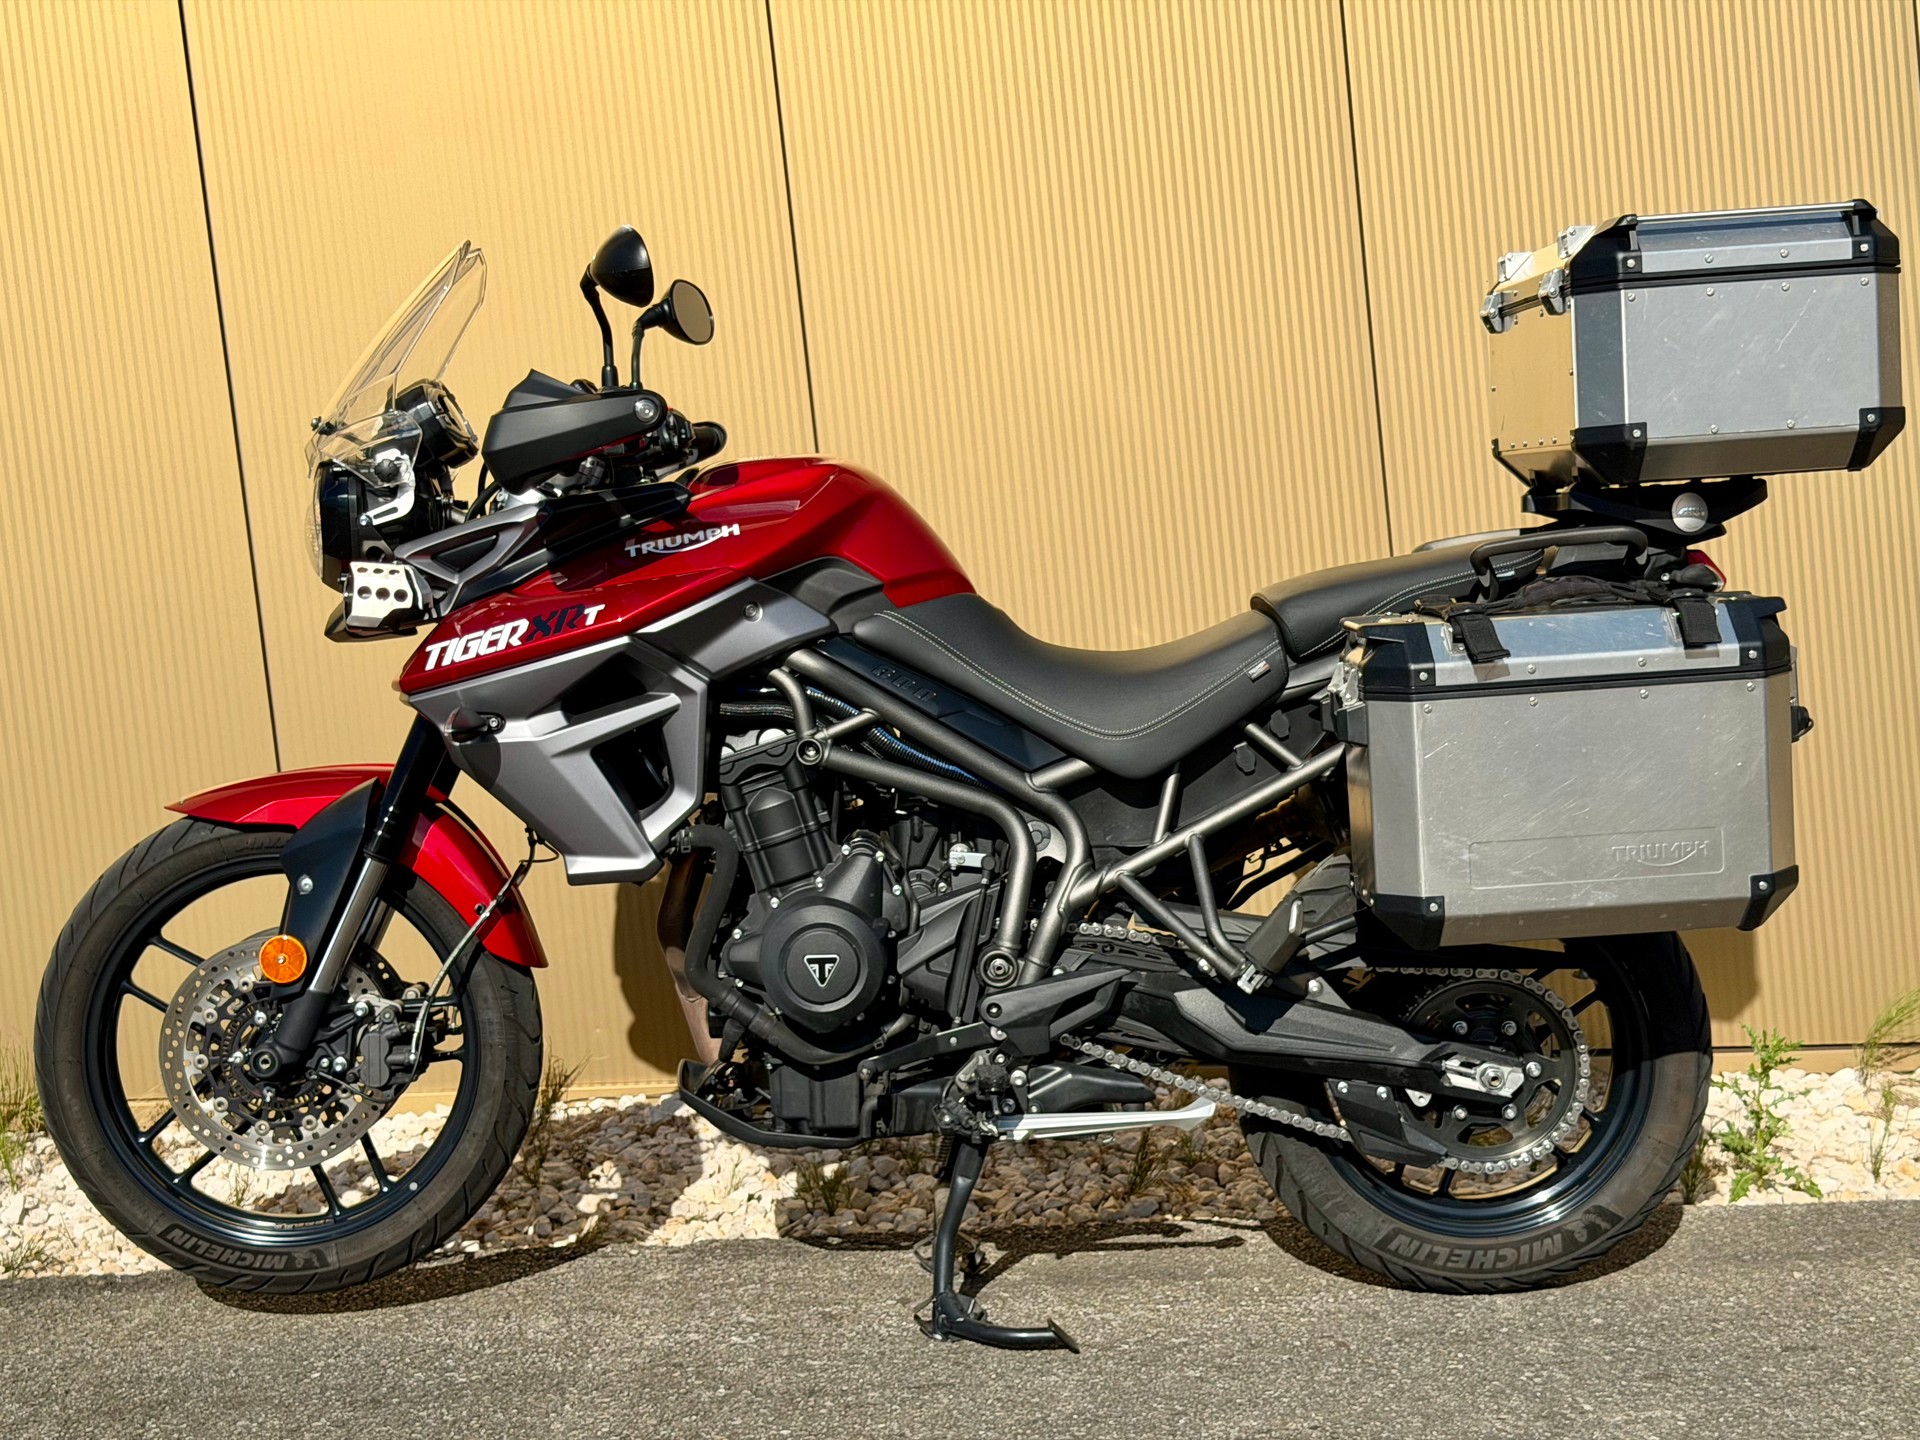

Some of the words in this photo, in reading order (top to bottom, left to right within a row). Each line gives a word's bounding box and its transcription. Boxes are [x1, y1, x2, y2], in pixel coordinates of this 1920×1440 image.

[625, 524, 740, 557] TRIUMPH
[425, 618, 530, 671] TIGER
[1611, 840, 1710, 864] TRIUMPH
[166, 1227, 289, 1270] MICHELIN
[1387, 1232, 1563, 1270] MICHELIN
